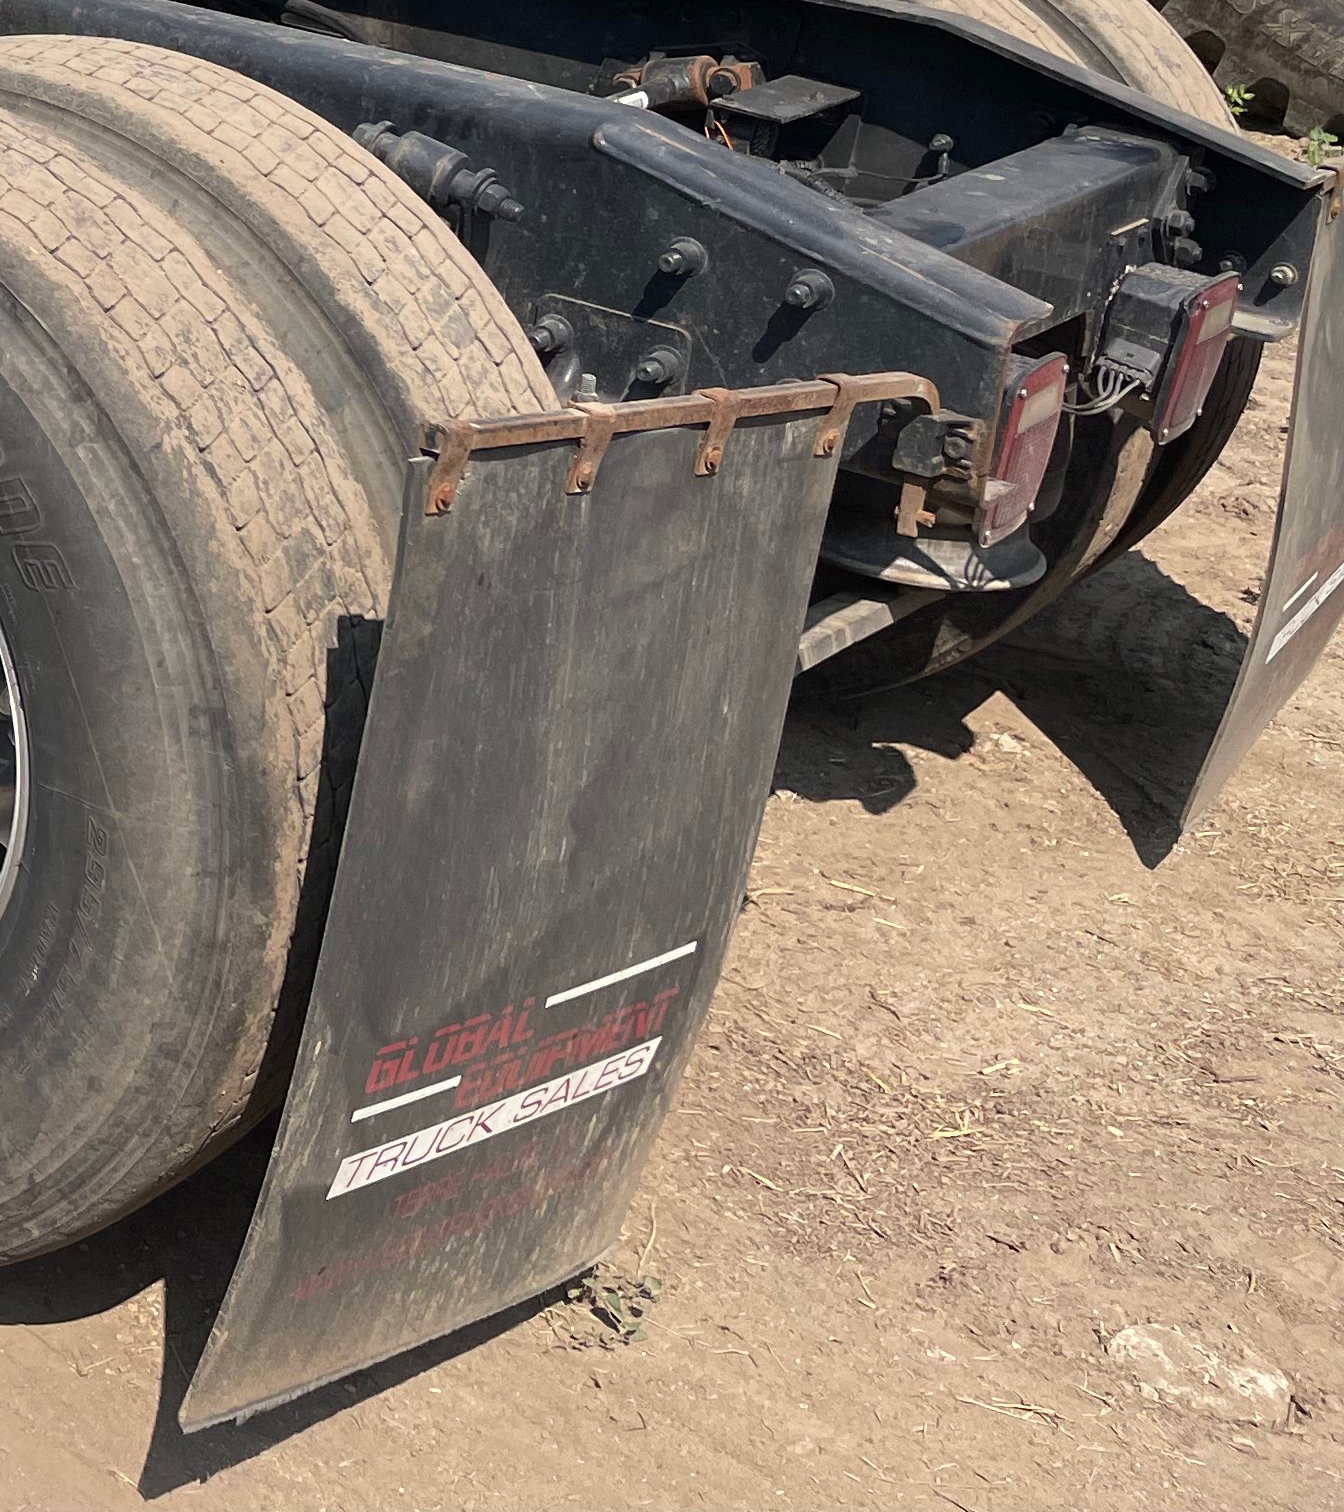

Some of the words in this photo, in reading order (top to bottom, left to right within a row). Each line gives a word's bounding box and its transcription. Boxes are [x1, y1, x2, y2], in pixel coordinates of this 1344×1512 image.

[365, 996, 536, 1095] GLOBAL
[453, 987, 681, 1110] EQUIPMENT
[346, 1101, 506, 1189] TRUCK
[512, 1044, 653, 1125] SALES
